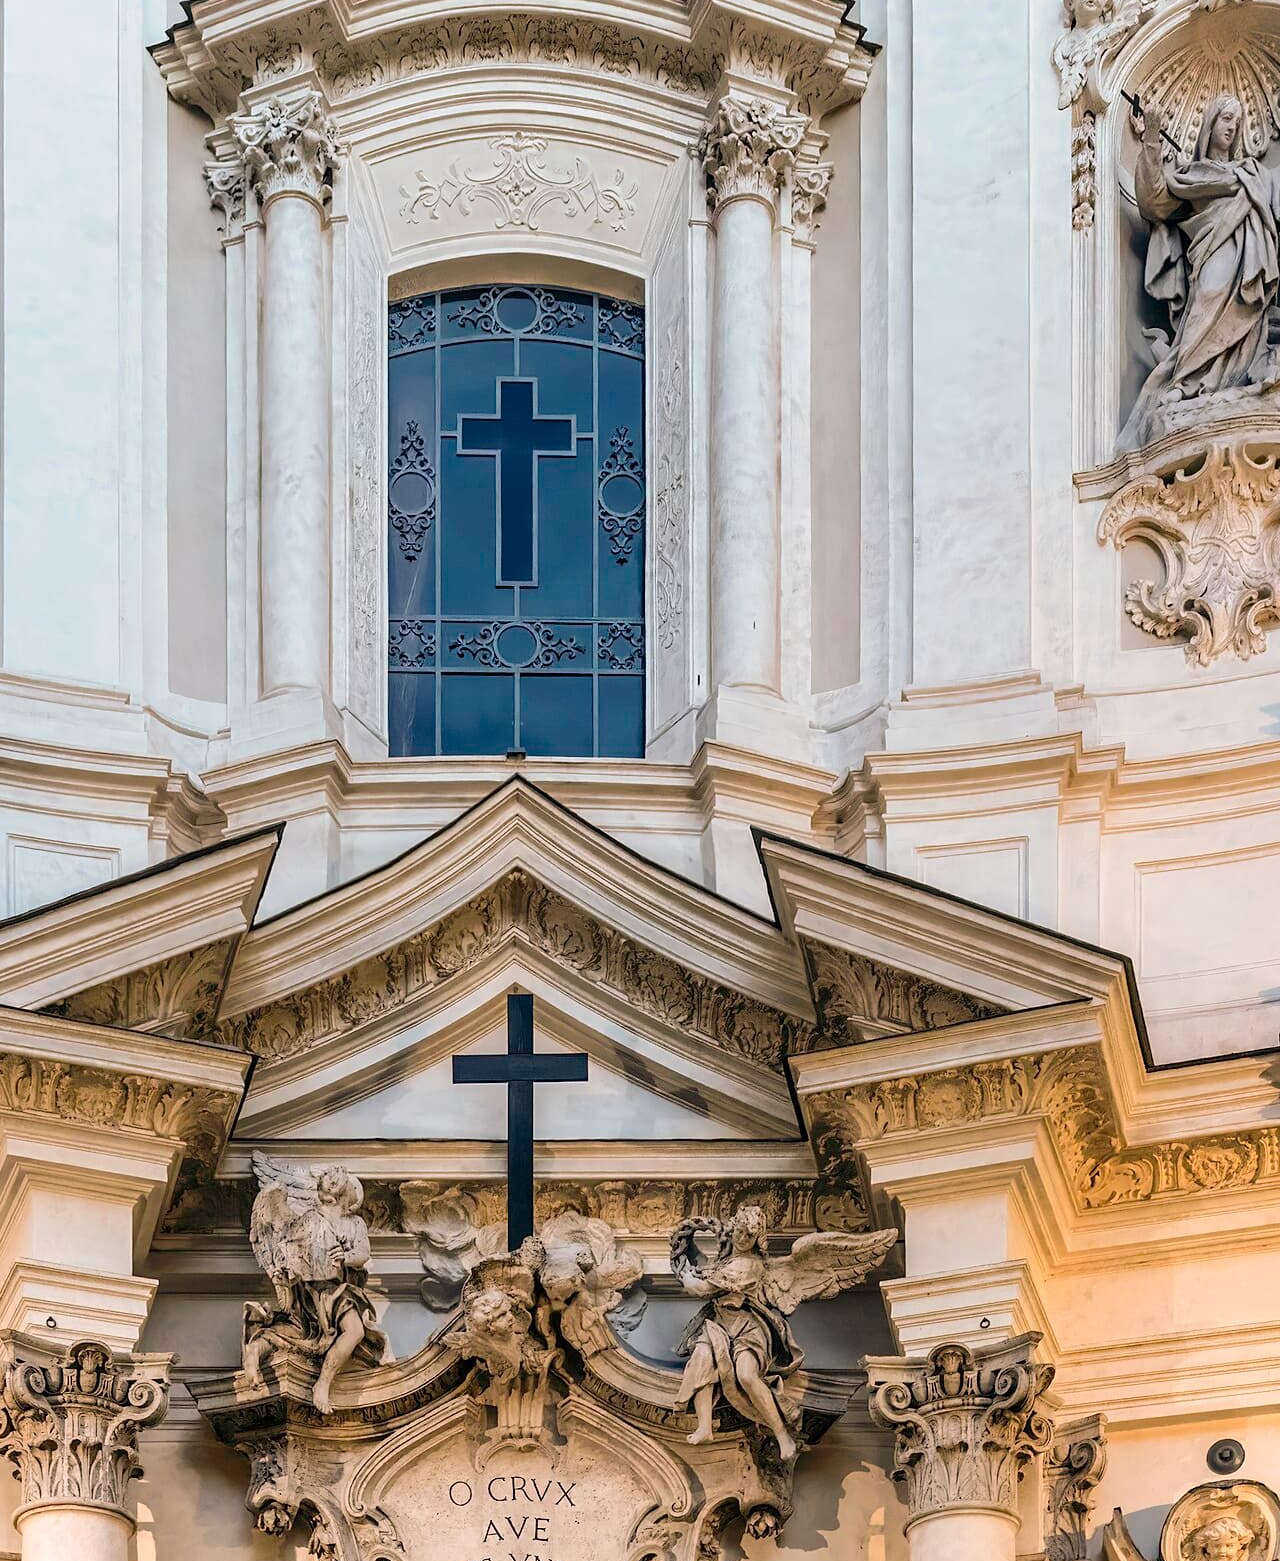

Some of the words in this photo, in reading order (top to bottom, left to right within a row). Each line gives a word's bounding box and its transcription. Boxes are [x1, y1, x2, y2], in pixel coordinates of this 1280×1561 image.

[449, 1481, 473, 1506] O
[487, 1476, 577, 1507] CRVX
[482, 1516, 550, 1543] AVE
